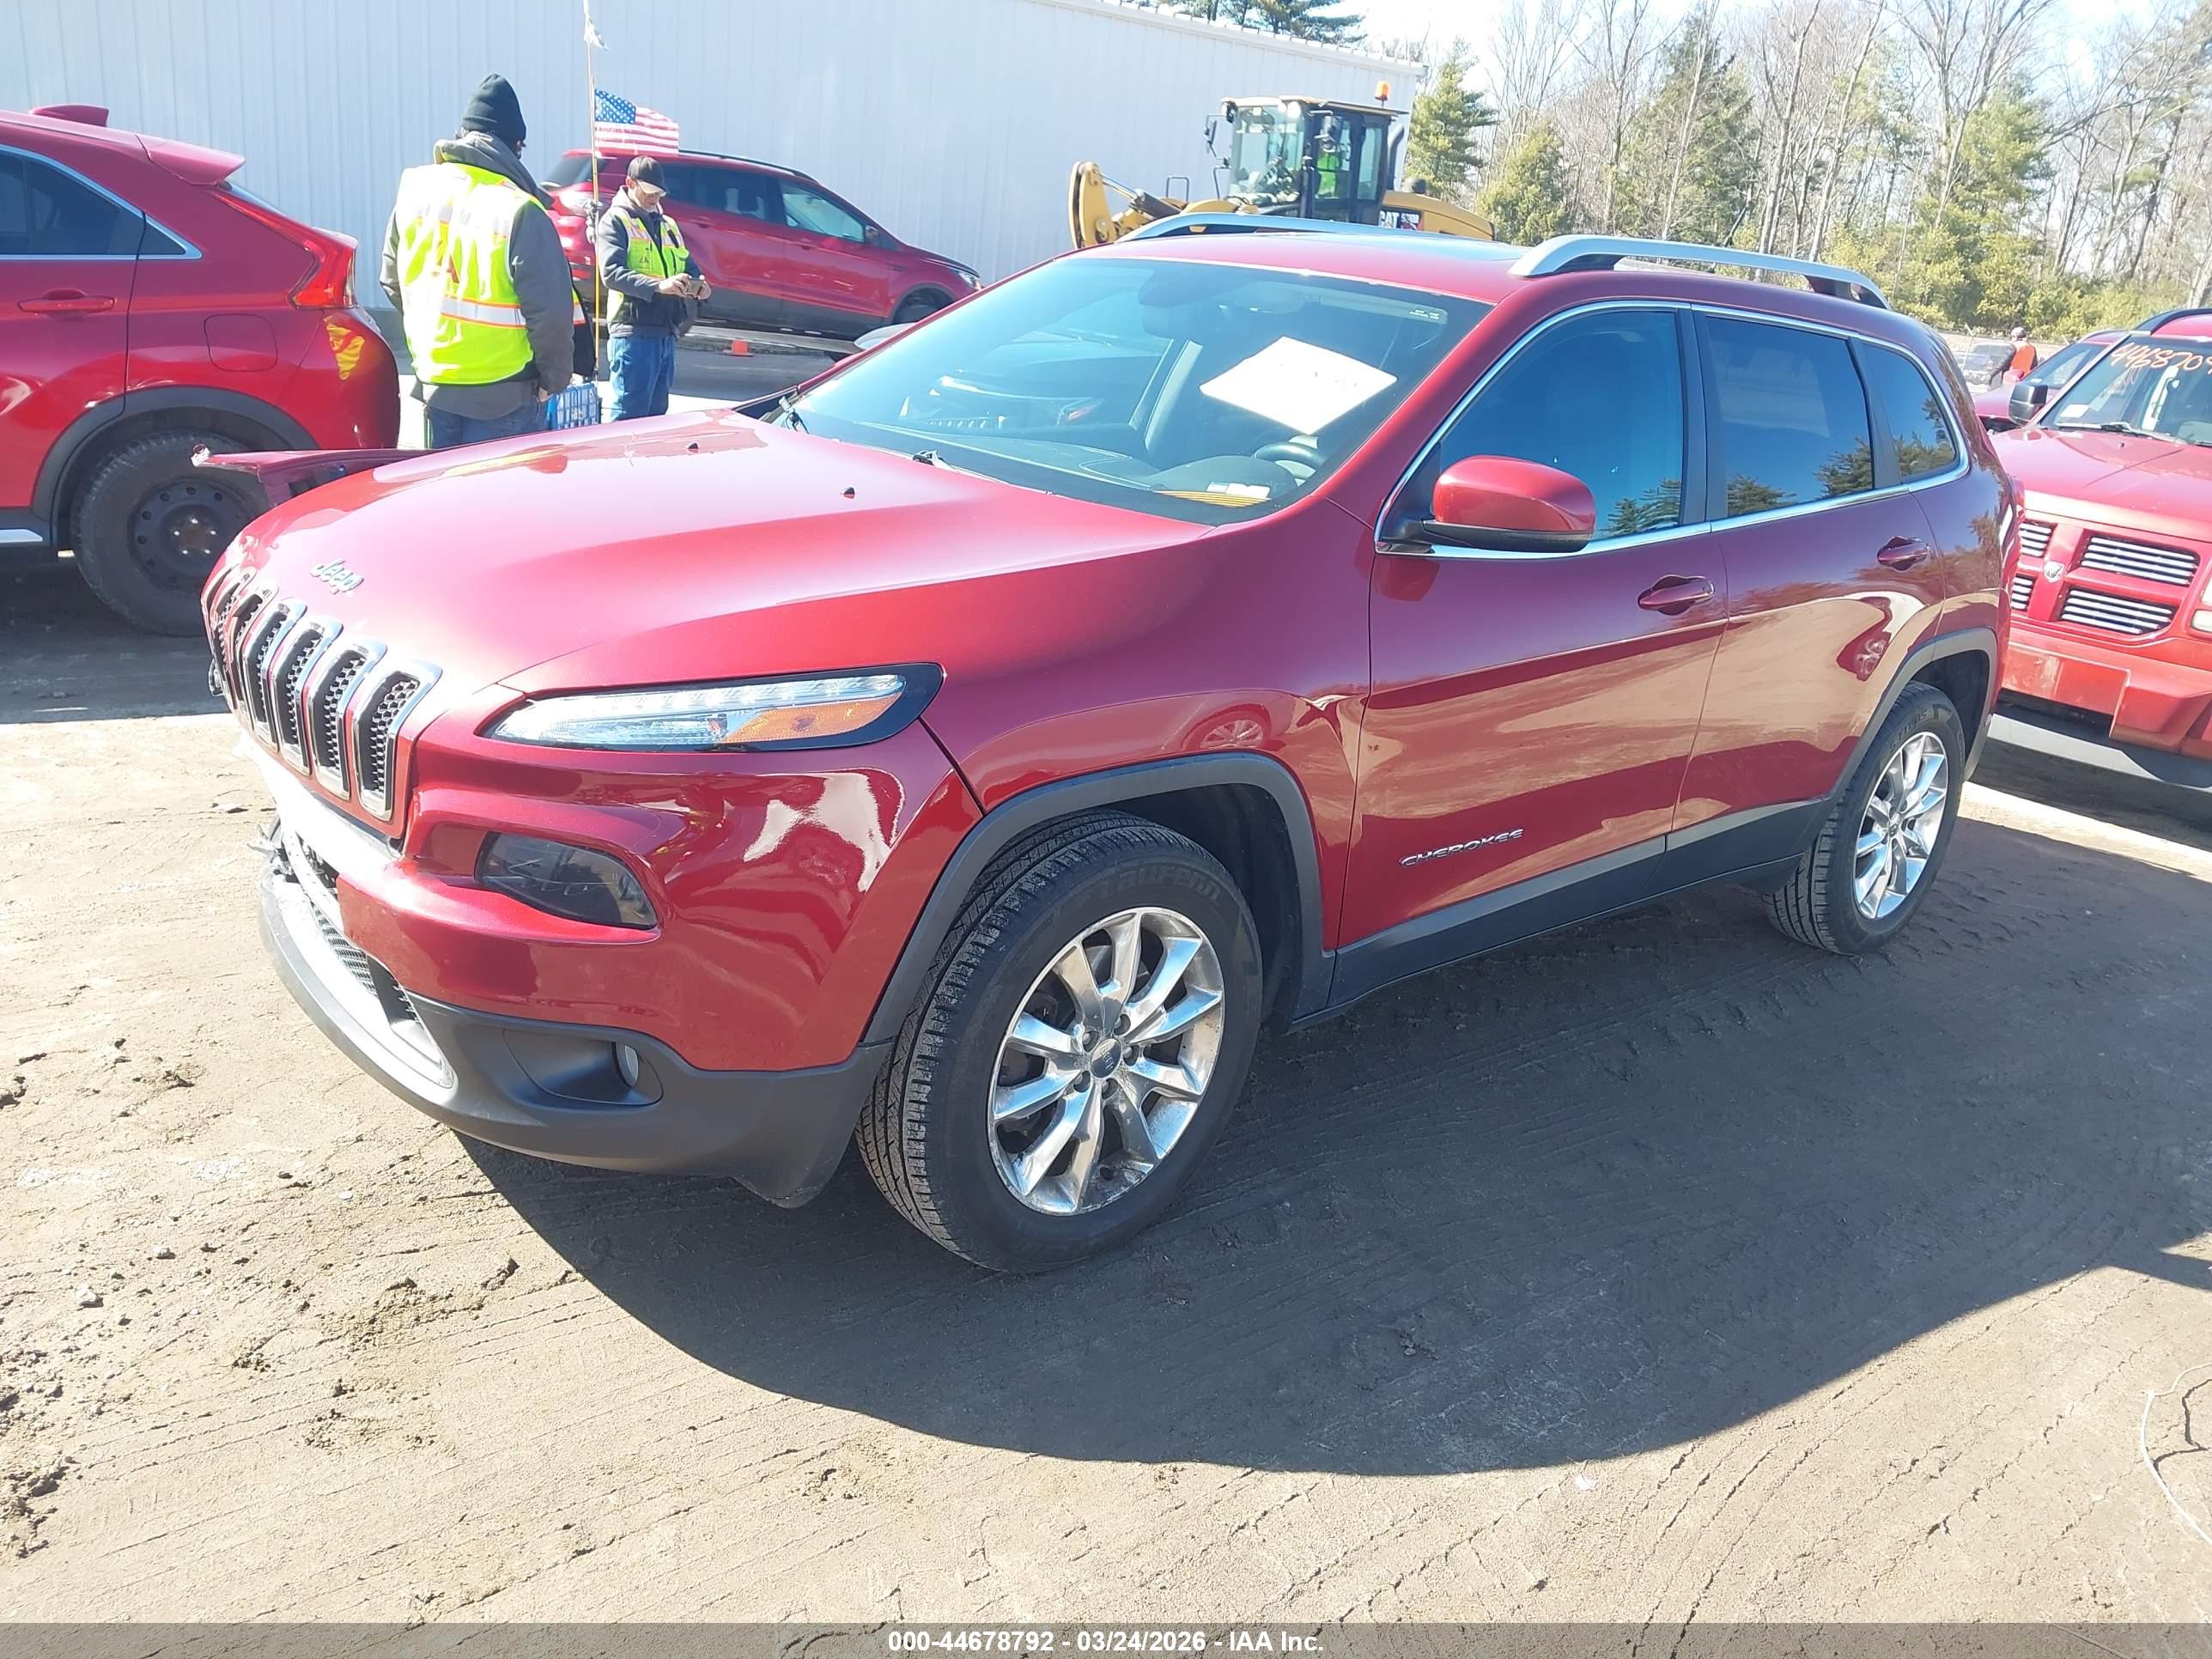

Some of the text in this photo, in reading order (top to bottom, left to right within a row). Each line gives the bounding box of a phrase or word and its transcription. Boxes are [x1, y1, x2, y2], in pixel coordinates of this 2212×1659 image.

[1378, 210, 1400, 228] CAT
[310, 557, 364, 595] Jeep
[1400, 828, 1524, 866] CHEROKEE
